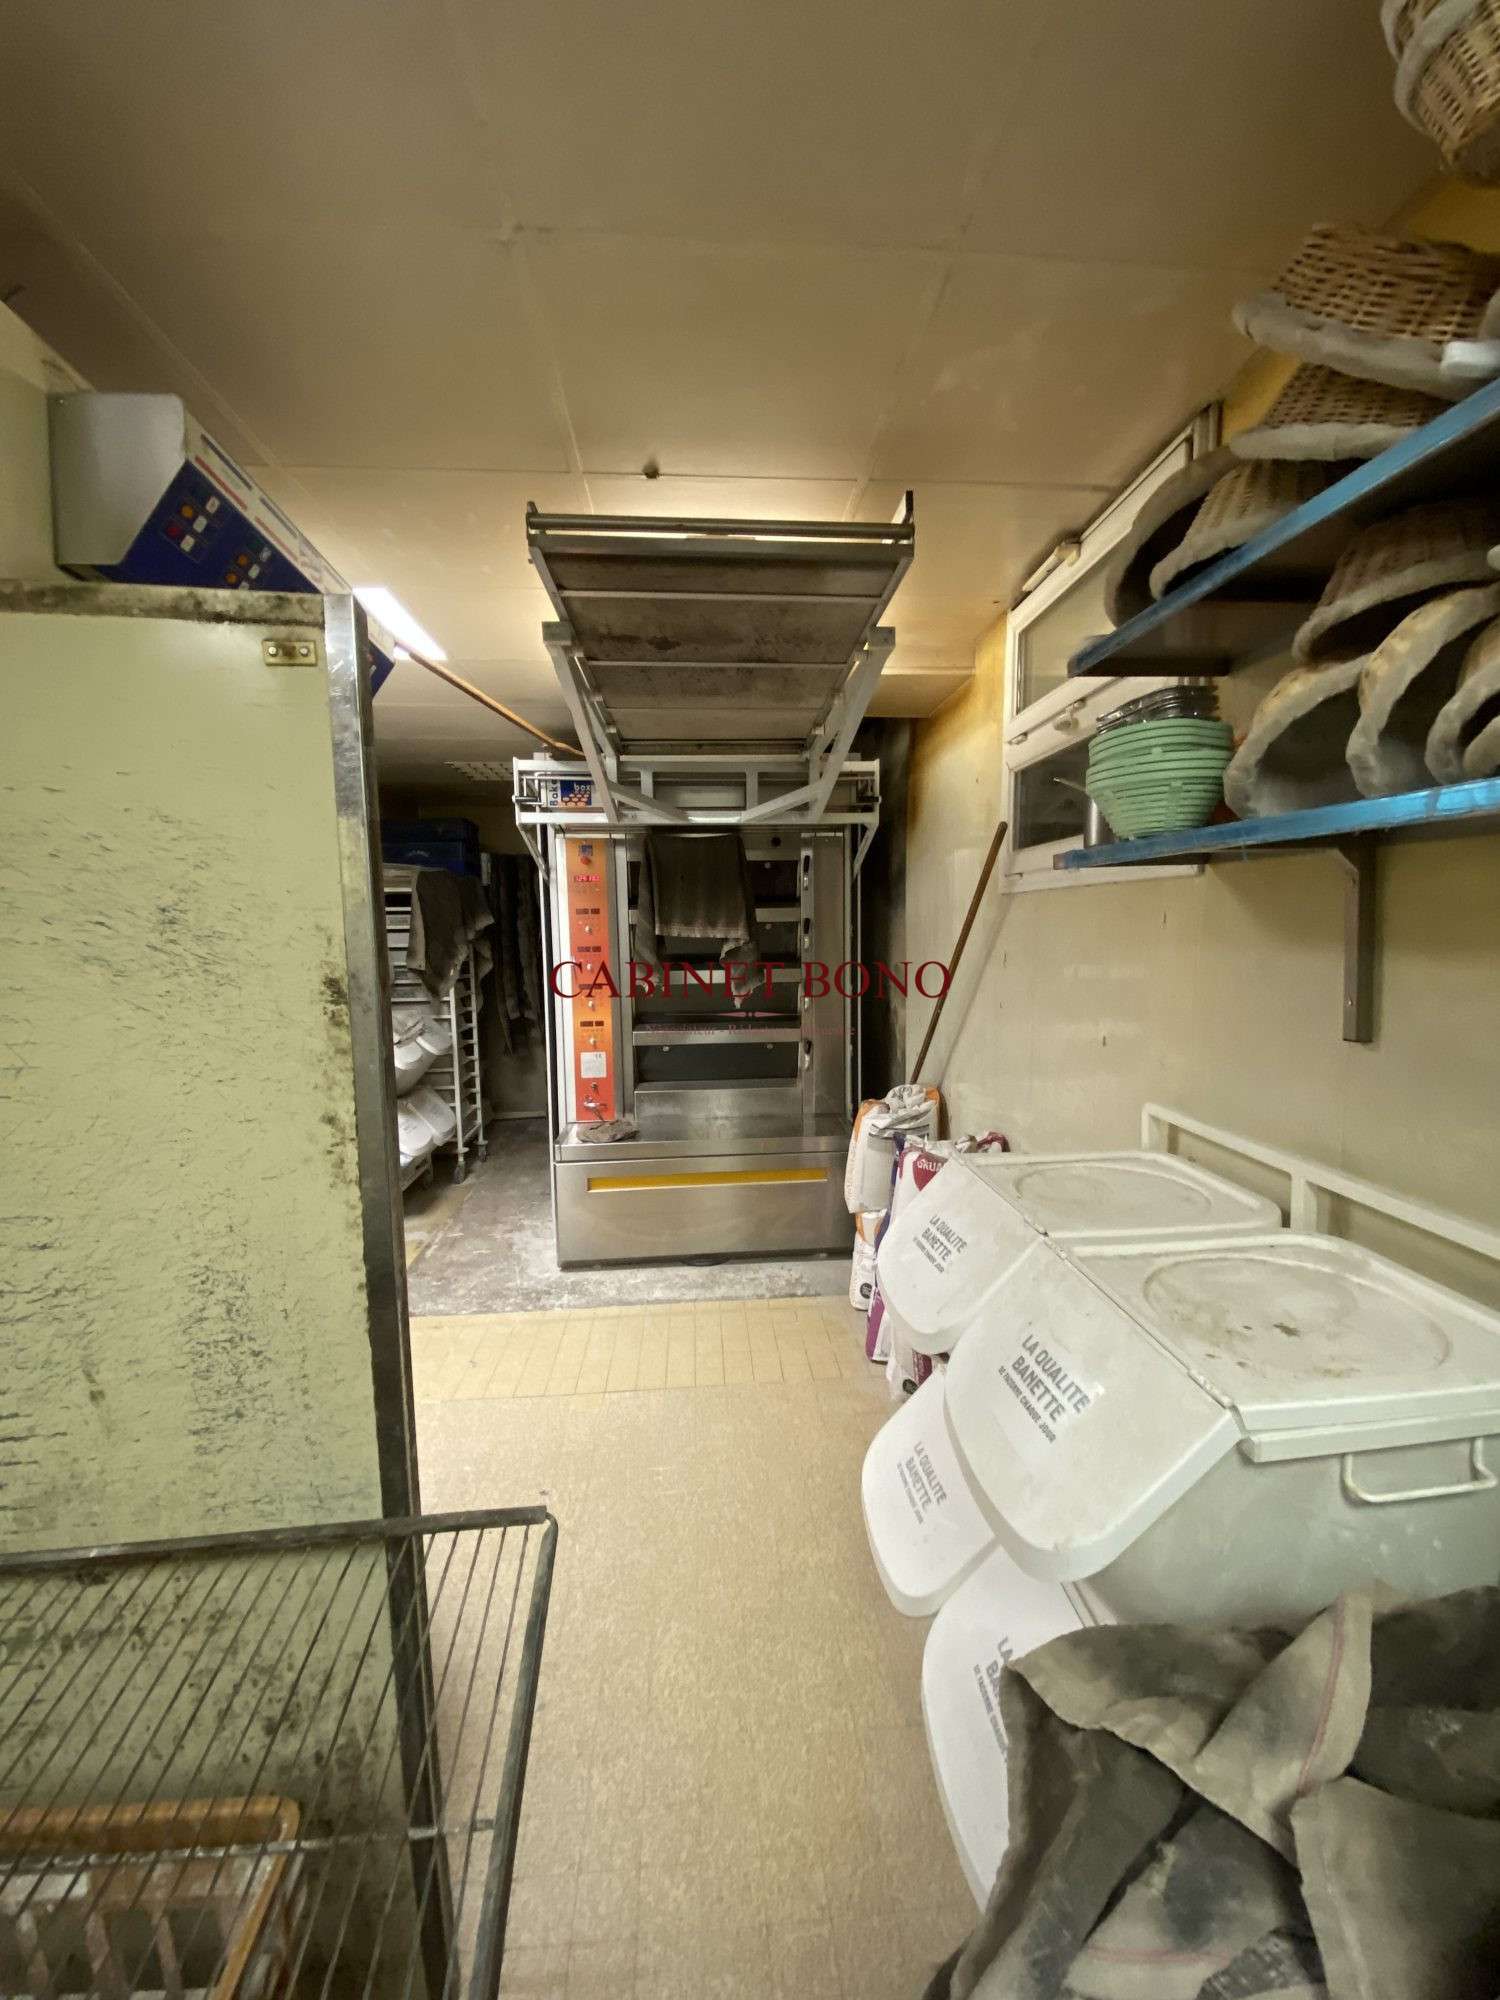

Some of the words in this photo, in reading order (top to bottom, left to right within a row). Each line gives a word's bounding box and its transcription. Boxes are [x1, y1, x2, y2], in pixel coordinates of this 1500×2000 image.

[573, 783, 591, 791] box
[929, 1214, 941, 1227] LA
[922, 1227, 951, 1261] BANETTE
[1012, 1355, 1065, 1422] BANETTE
[1022, 1334, 1040, 1356] LA
[1035, 1349, 1090, 1414] QUALITE
